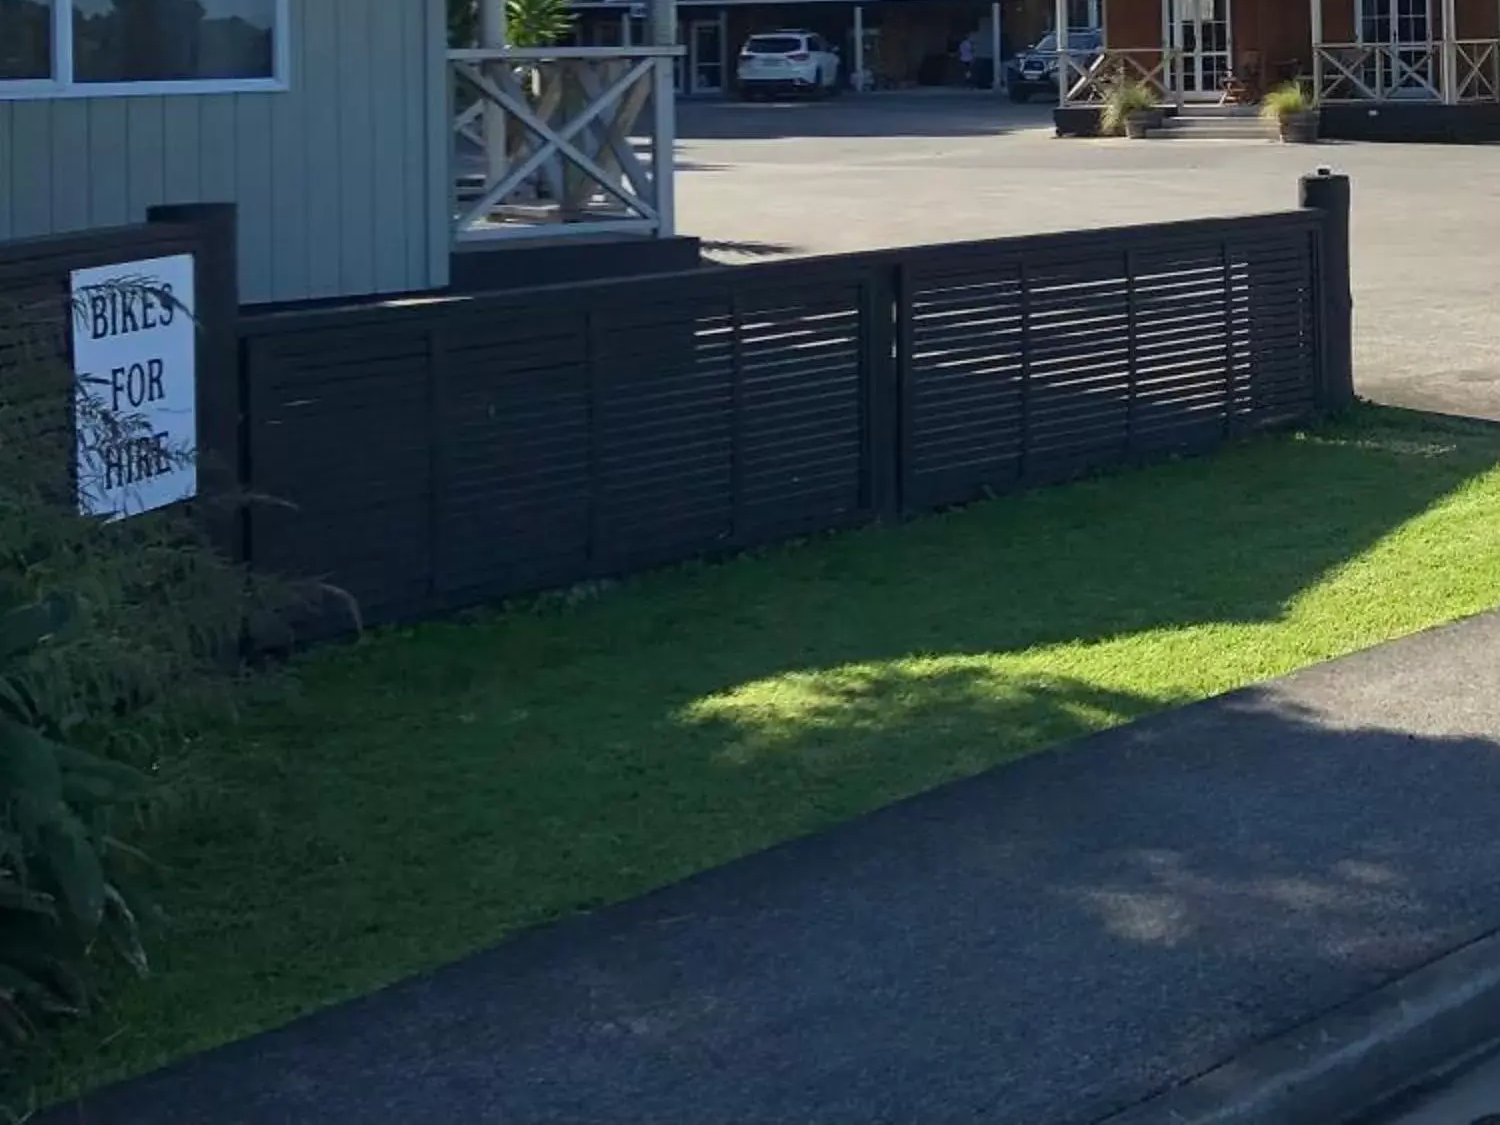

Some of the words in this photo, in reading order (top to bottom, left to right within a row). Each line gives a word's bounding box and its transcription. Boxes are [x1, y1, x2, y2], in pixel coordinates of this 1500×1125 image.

[90, 283, 174, 339] BIKES
[111, 358, 165, 412] FOR
[105, 431, 173, 490] HIRE
